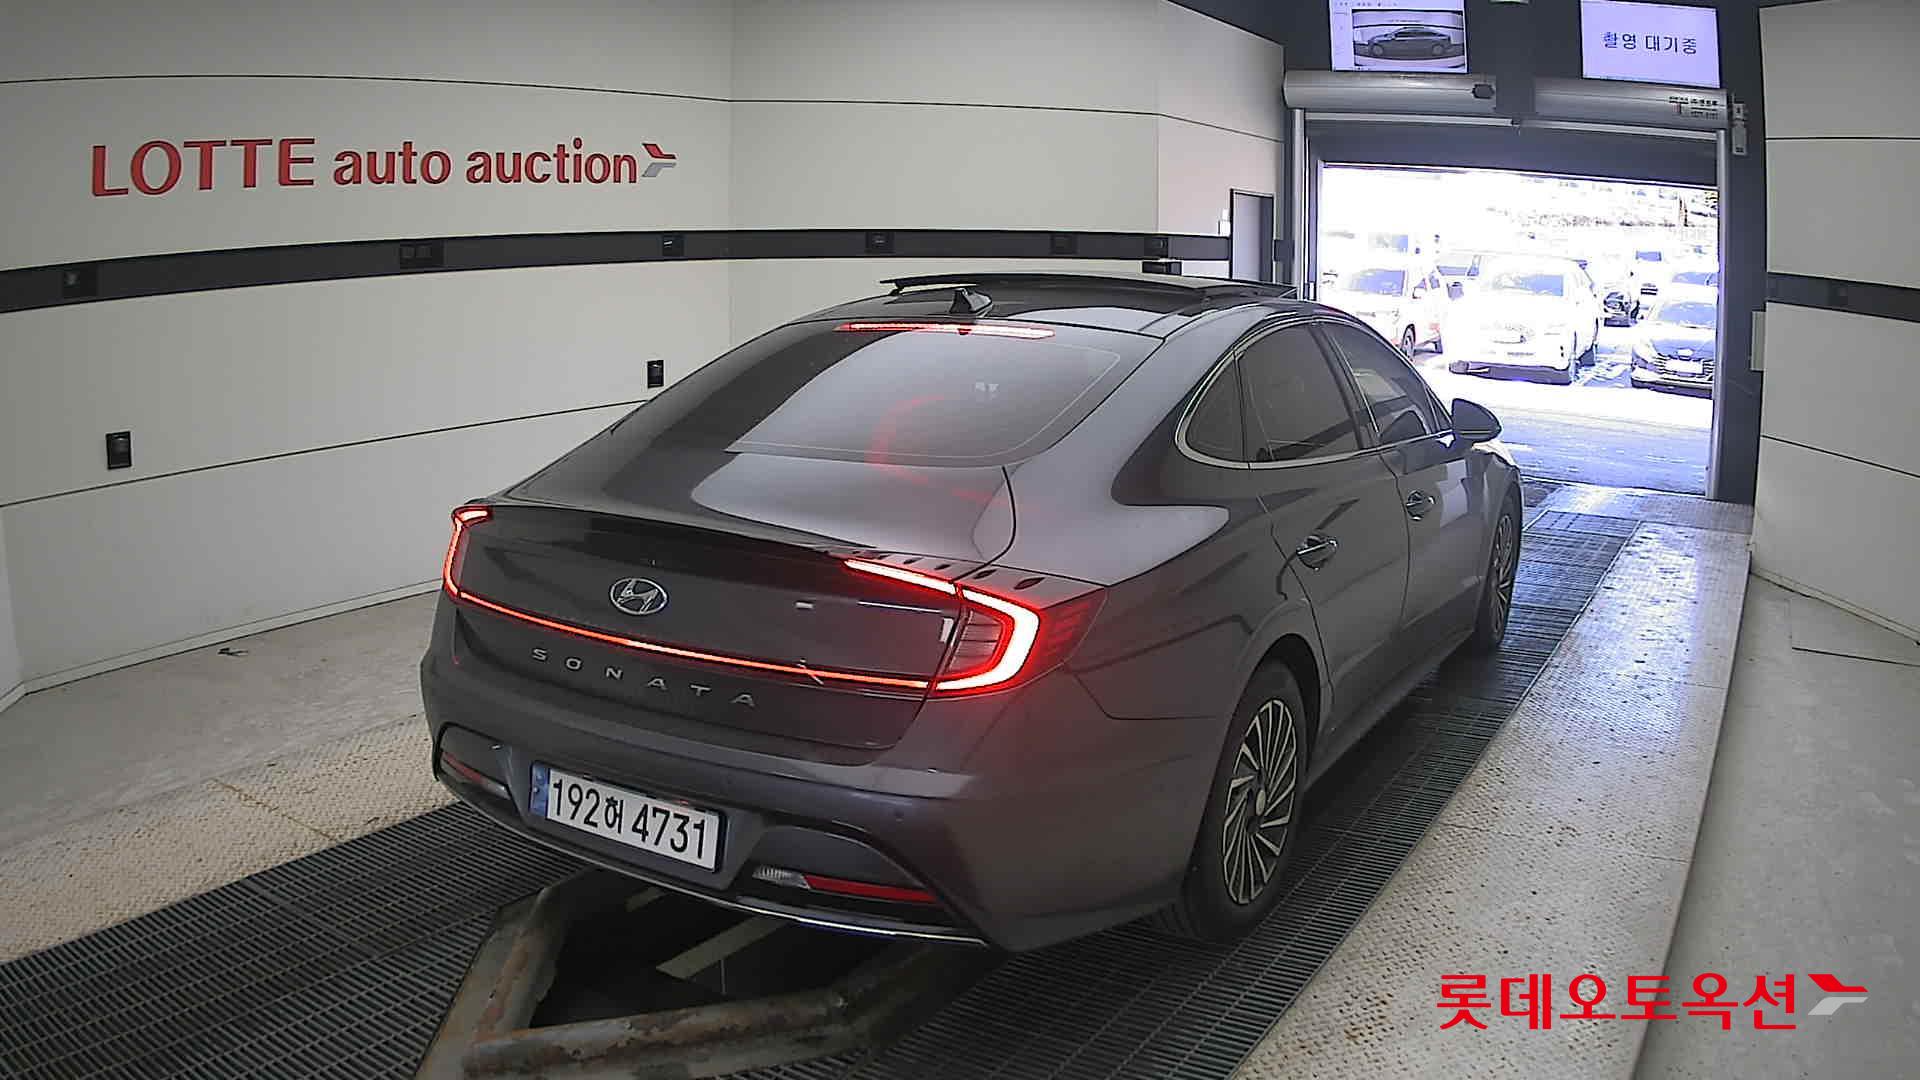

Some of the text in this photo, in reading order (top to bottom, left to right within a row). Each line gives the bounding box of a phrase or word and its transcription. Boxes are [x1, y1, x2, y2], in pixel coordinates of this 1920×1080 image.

[1645, 34, 1697, 55] 대기중
[91, 137, 639, 197] LOTTE auto auction
[532, 648, 756, 708] SONATA
[553, 778, 706, 860] 192허 4731
